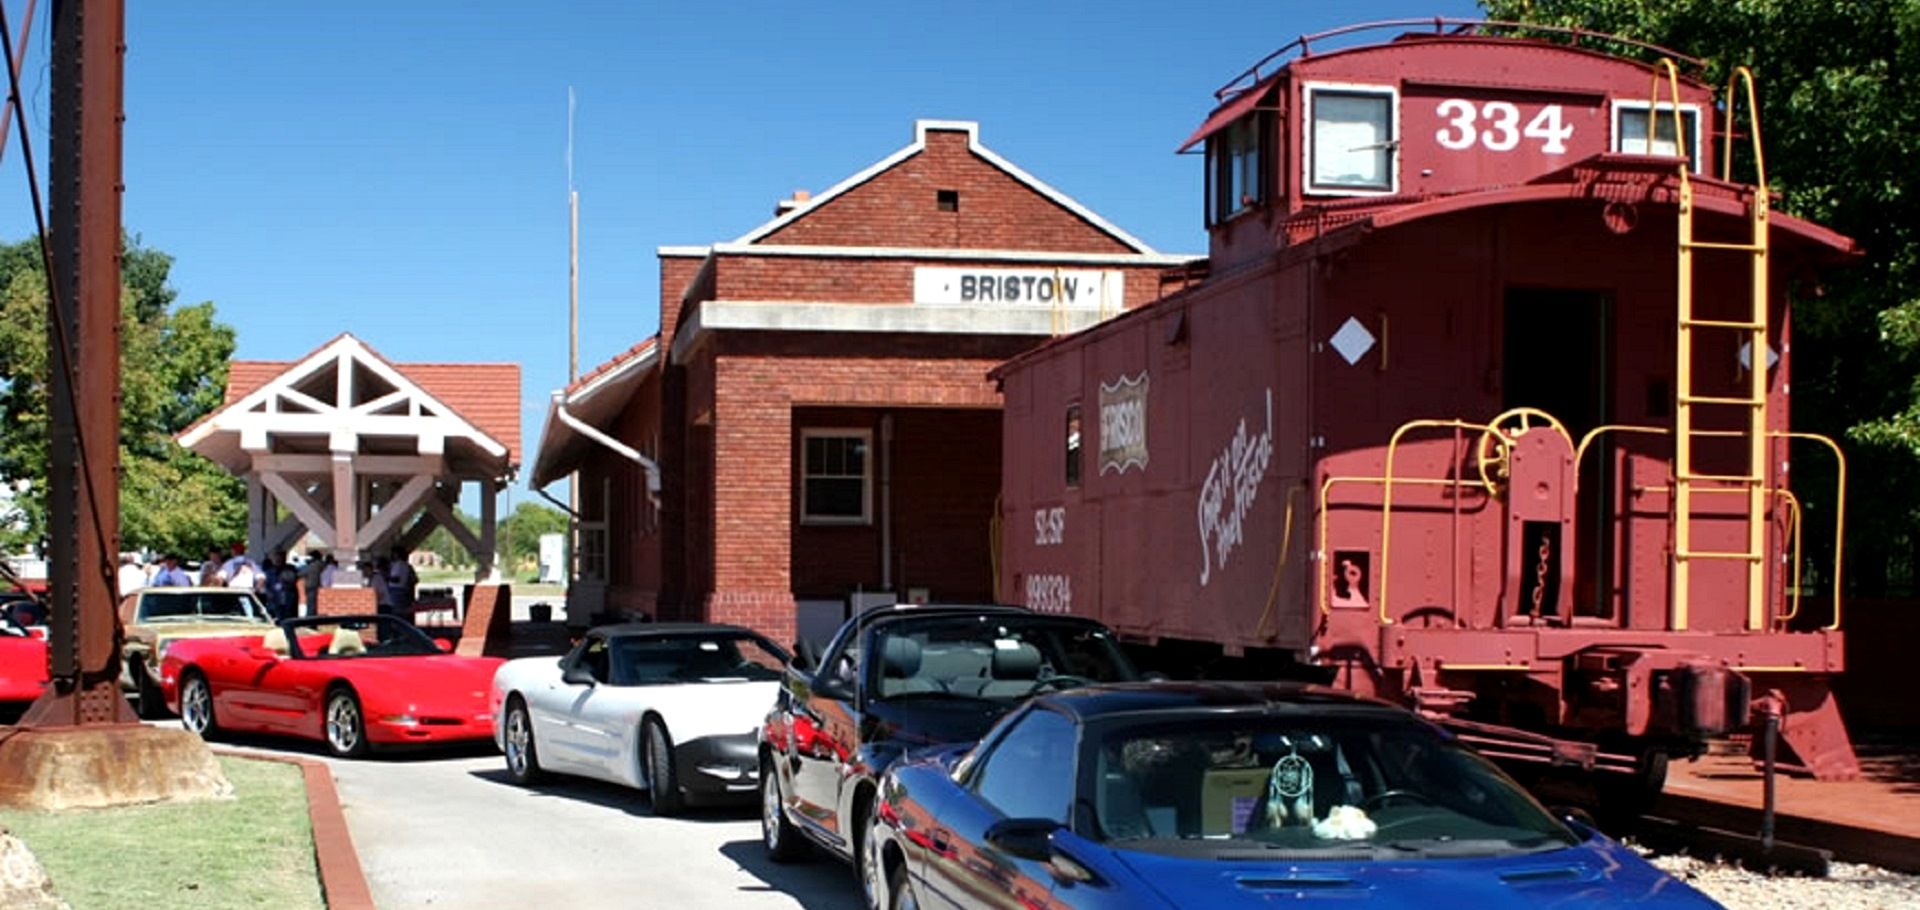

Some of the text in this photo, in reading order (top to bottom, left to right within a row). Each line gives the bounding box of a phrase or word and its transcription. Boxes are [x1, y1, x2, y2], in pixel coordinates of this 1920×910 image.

[1436, 98, 1574, 154] 334
[960, 274, 1078, 302] BRISTOW
[1101, 399, 1145, 452] FRISCO
[1198, 458, 1222, 587] Ship
[1220, 447, 1231, 499] it
[1216, 511, 1238, 570] the
